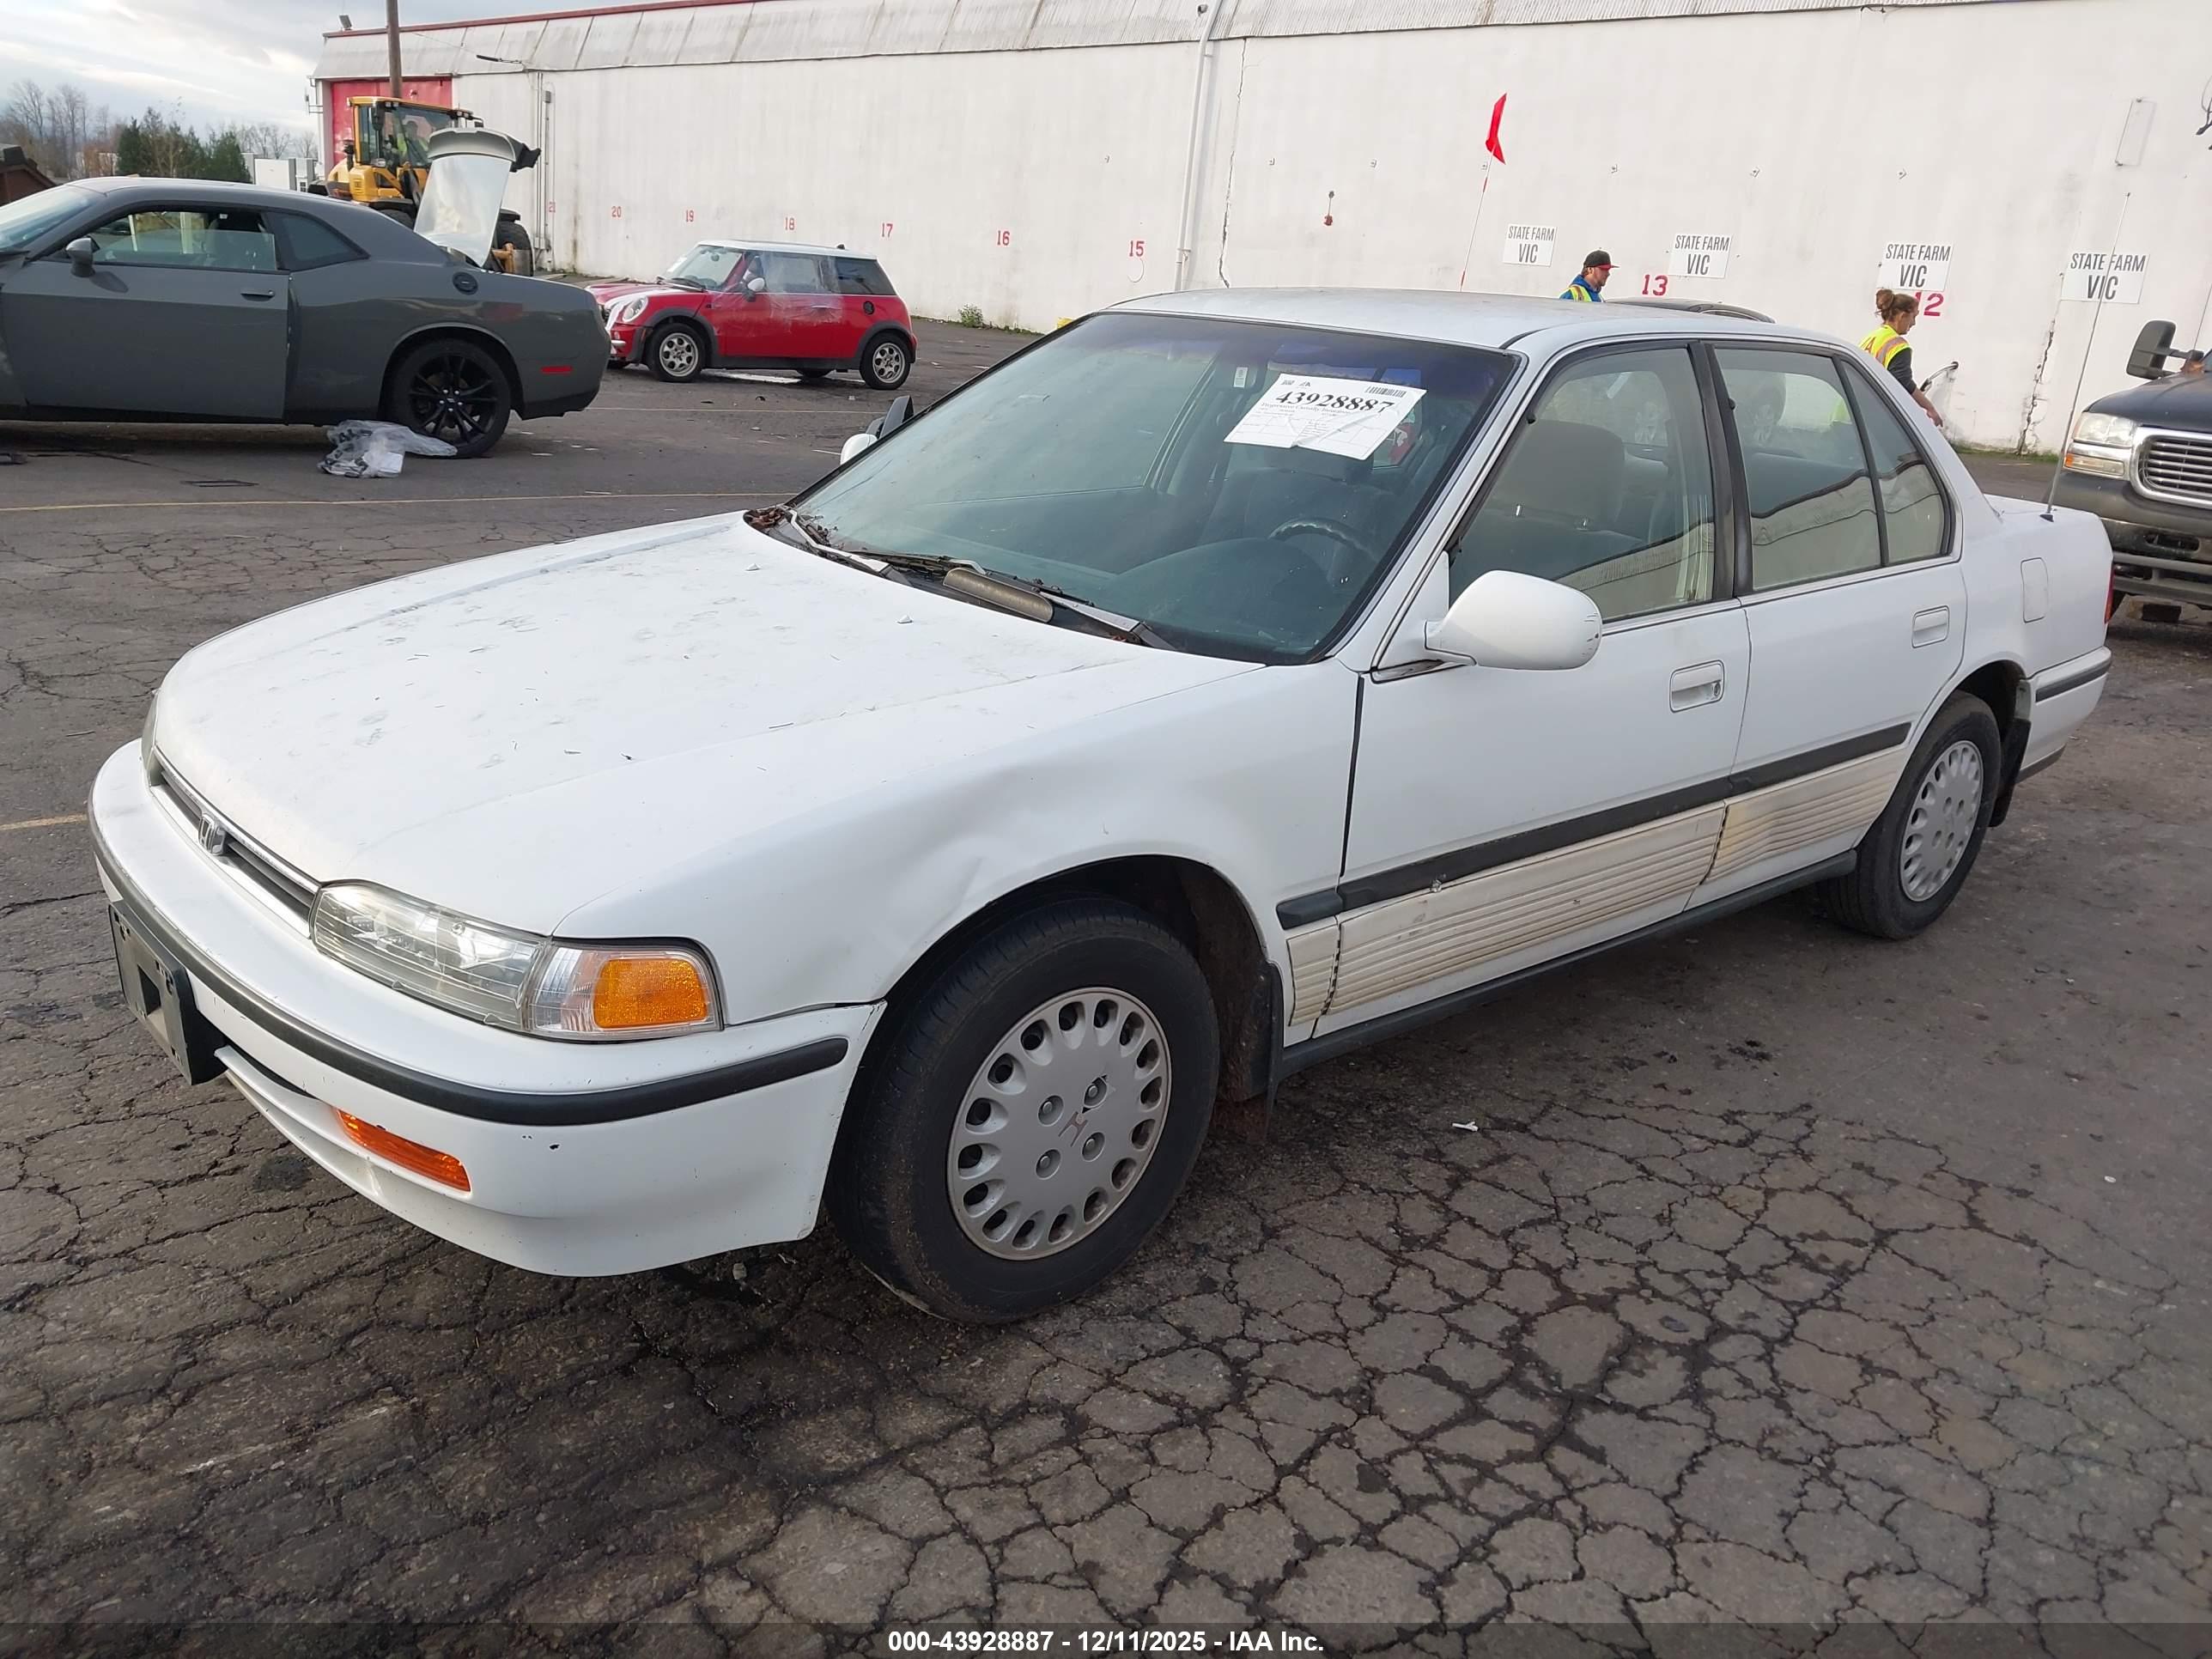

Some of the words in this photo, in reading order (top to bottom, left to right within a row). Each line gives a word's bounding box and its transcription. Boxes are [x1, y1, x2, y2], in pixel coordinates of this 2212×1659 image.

[611, 206, 622, 217] 20
[685, 210, 694, 222] 19
[785, 217, 795, 230] 18
[881, 222, 894, 238] 17
[997, 230, 1011, 246] 16
[1508, 226, 1530, 240] STATE
[1531, 227, 1554, 241] FARM
[1129, 240, 1145, 257] 15
[1674, 234, 1701, 250] STATE
[1702, 236, 1729, 252] FARM
[1519, 243, 1538, 264] VIC
[1886, 244, 1917, 259] STATE
[1917, 245, 1951, 261] FARM
[1687, 253, 1711, 275] VIC
[2070, 253, 2106, 270] STATE
[2109, 254, 2146, 271] FARM
[1899, 264, 1927, 288] VIC
[1642, 274, 1668, 296] 13
[2087, 275, 2118, 300] VIC
[1275, 391, 1395, 413] 43928887
